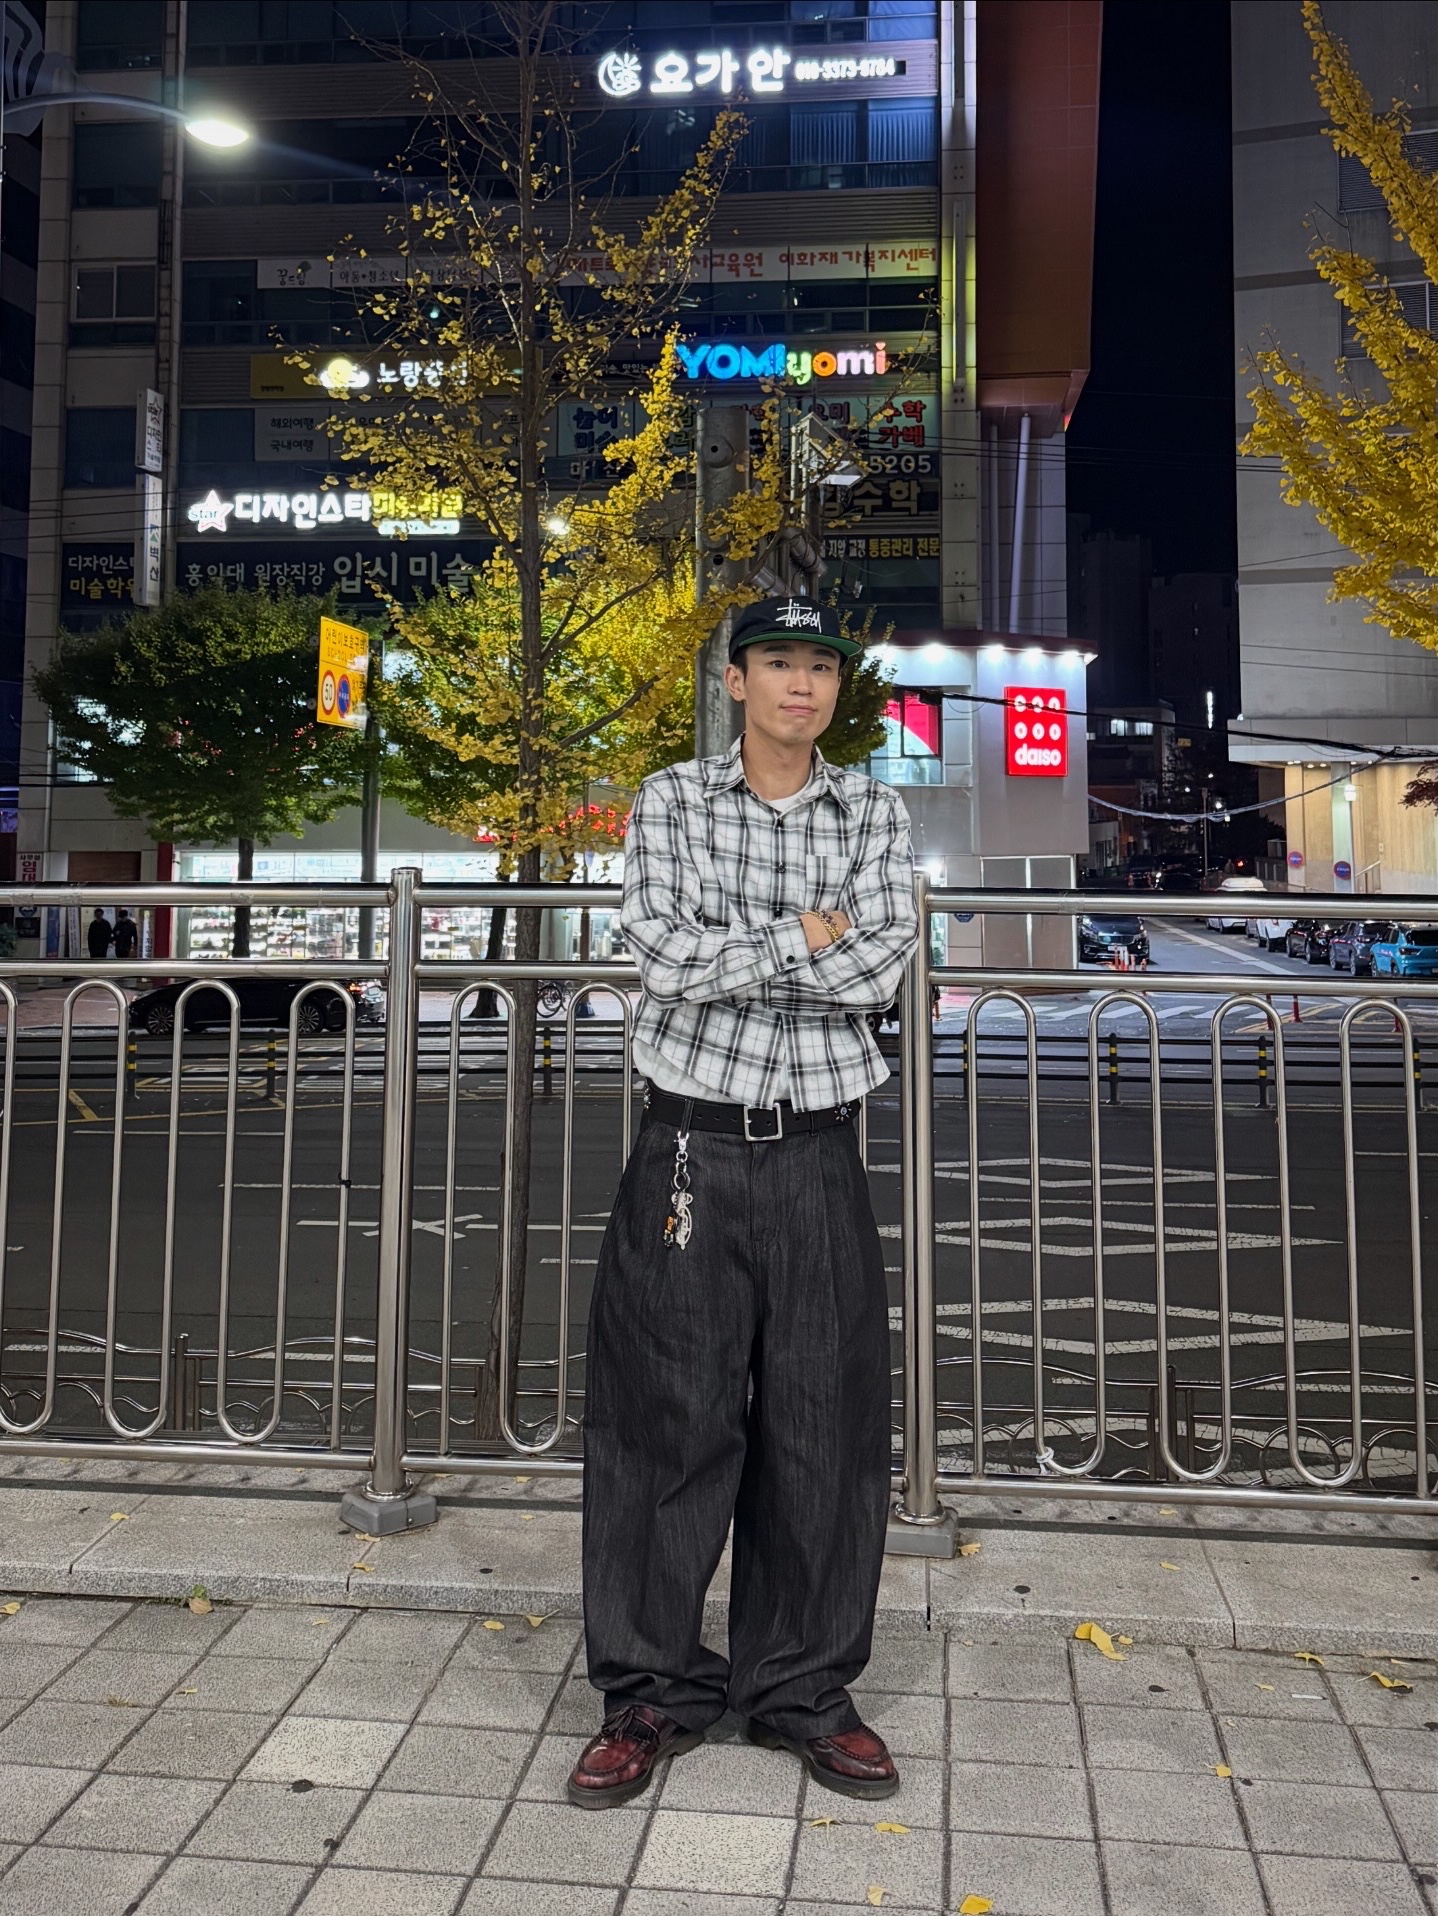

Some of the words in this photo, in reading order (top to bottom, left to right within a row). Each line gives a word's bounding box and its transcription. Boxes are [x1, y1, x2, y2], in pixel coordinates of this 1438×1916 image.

[650, 49, 791, 93] 요가안
[676, 342, 886, 385] YOMIyomi
[270, 417, 314, 431] 해외여행
[270, 440, 314, 453] 국내여행
[869, 454, 932, 475] 5205
[188, 508, 218, 521] star
[234, 492, 371, 529] 디자인스타
[869, 537, 913, 558] 통증관리
[917, 537, 940, 557] 전문
[254, 562, 326, 587] 원장직강
[333, 551, 398, 594] 입시
[409, 550, 473, 593] 미술
[324, 683, 334, 702] 50
[1014, 743, 1062, 767] daiso
